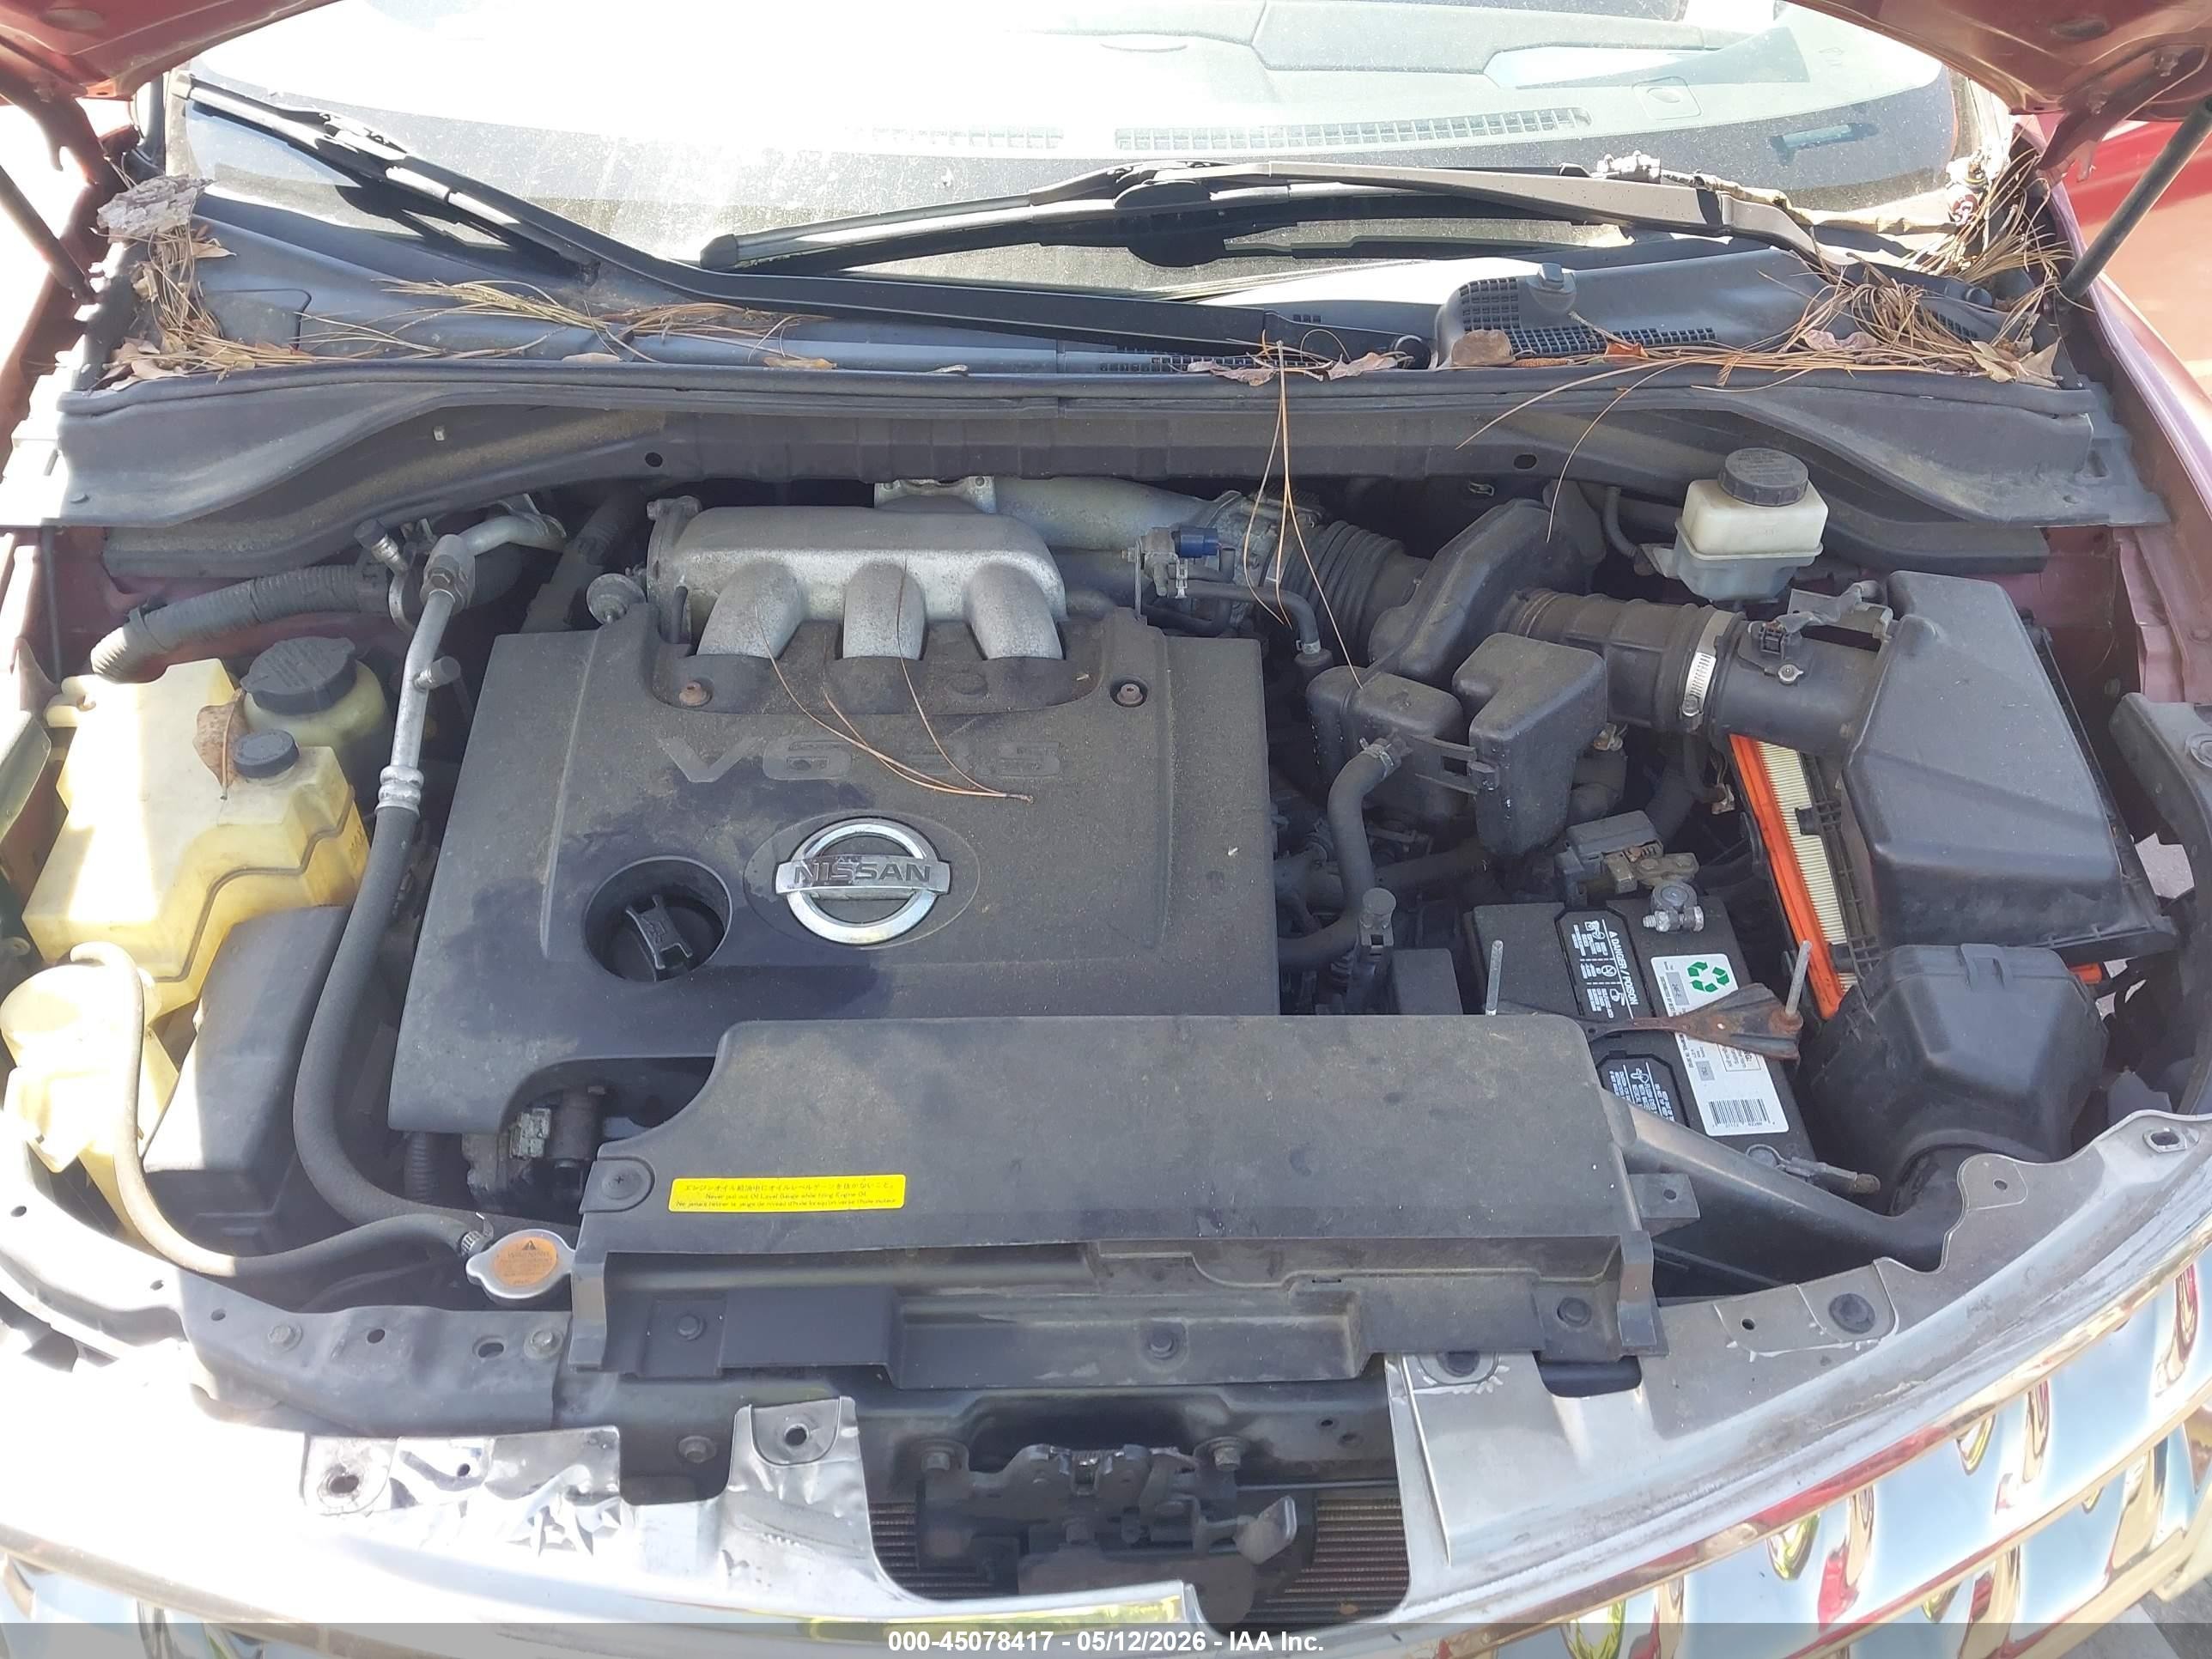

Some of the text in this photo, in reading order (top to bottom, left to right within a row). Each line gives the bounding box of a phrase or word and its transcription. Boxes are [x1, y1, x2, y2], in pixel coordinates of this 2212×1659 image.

[794, 862, 931, 884] NISSAN
[1611, 939, 1628, 969] DANGER
[1623, 976, 1639, 1005] POISON
